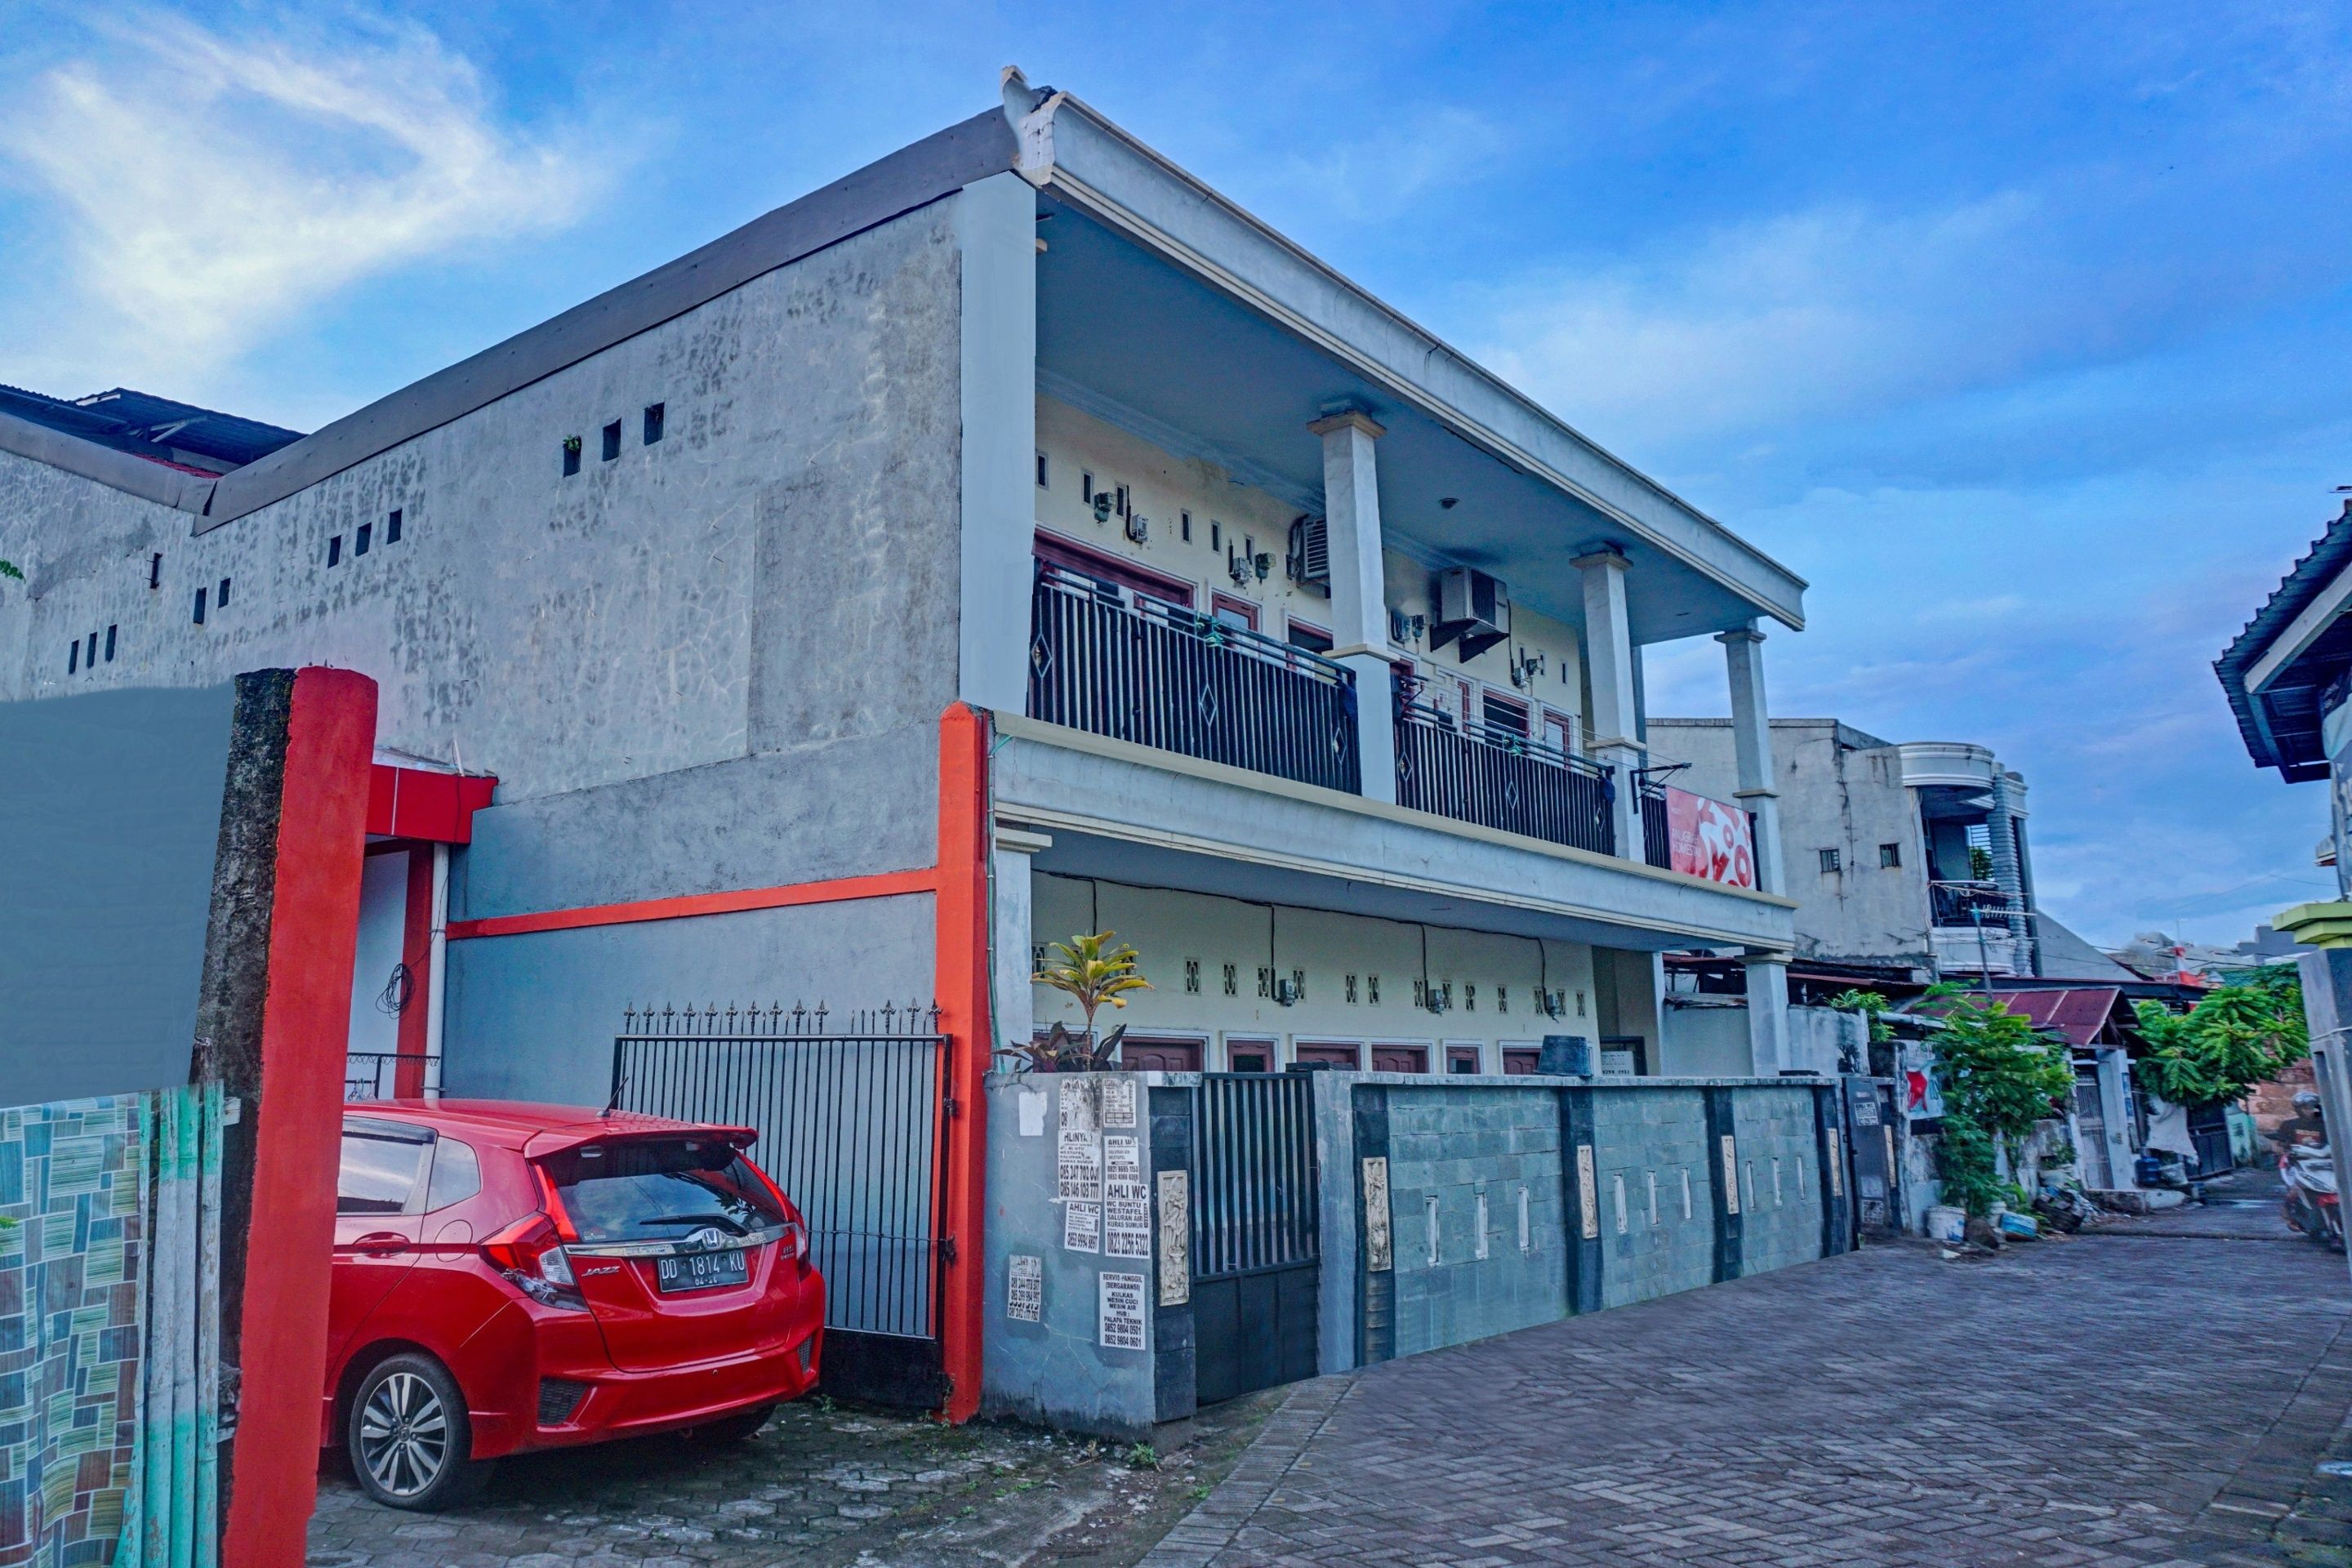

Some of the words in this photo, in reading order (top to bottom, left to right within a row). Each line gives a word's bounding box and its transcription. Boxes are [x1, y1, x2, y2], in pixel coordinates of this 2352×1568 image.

[1090, 1182, 1099, 1199] 777
[1107, 1184, 1129, 1198] AHLI
[1132, 1185, 1147, 1199] WC
[1070, 1203, 1086, 1212] AHLI
[1088, 1205, 1099, 1214] WC
[661, 1259, 677, 1279] DD
[689, 1254, 720, 1276] 1814
[729, 1252, 745, 1272] KU
[581, 1266, 621, 1277] JAZZ
[1102, 1273, 1120, 1281] SERVIS
[1106, 1282, 1140, 1292] (BERGARANSI)
